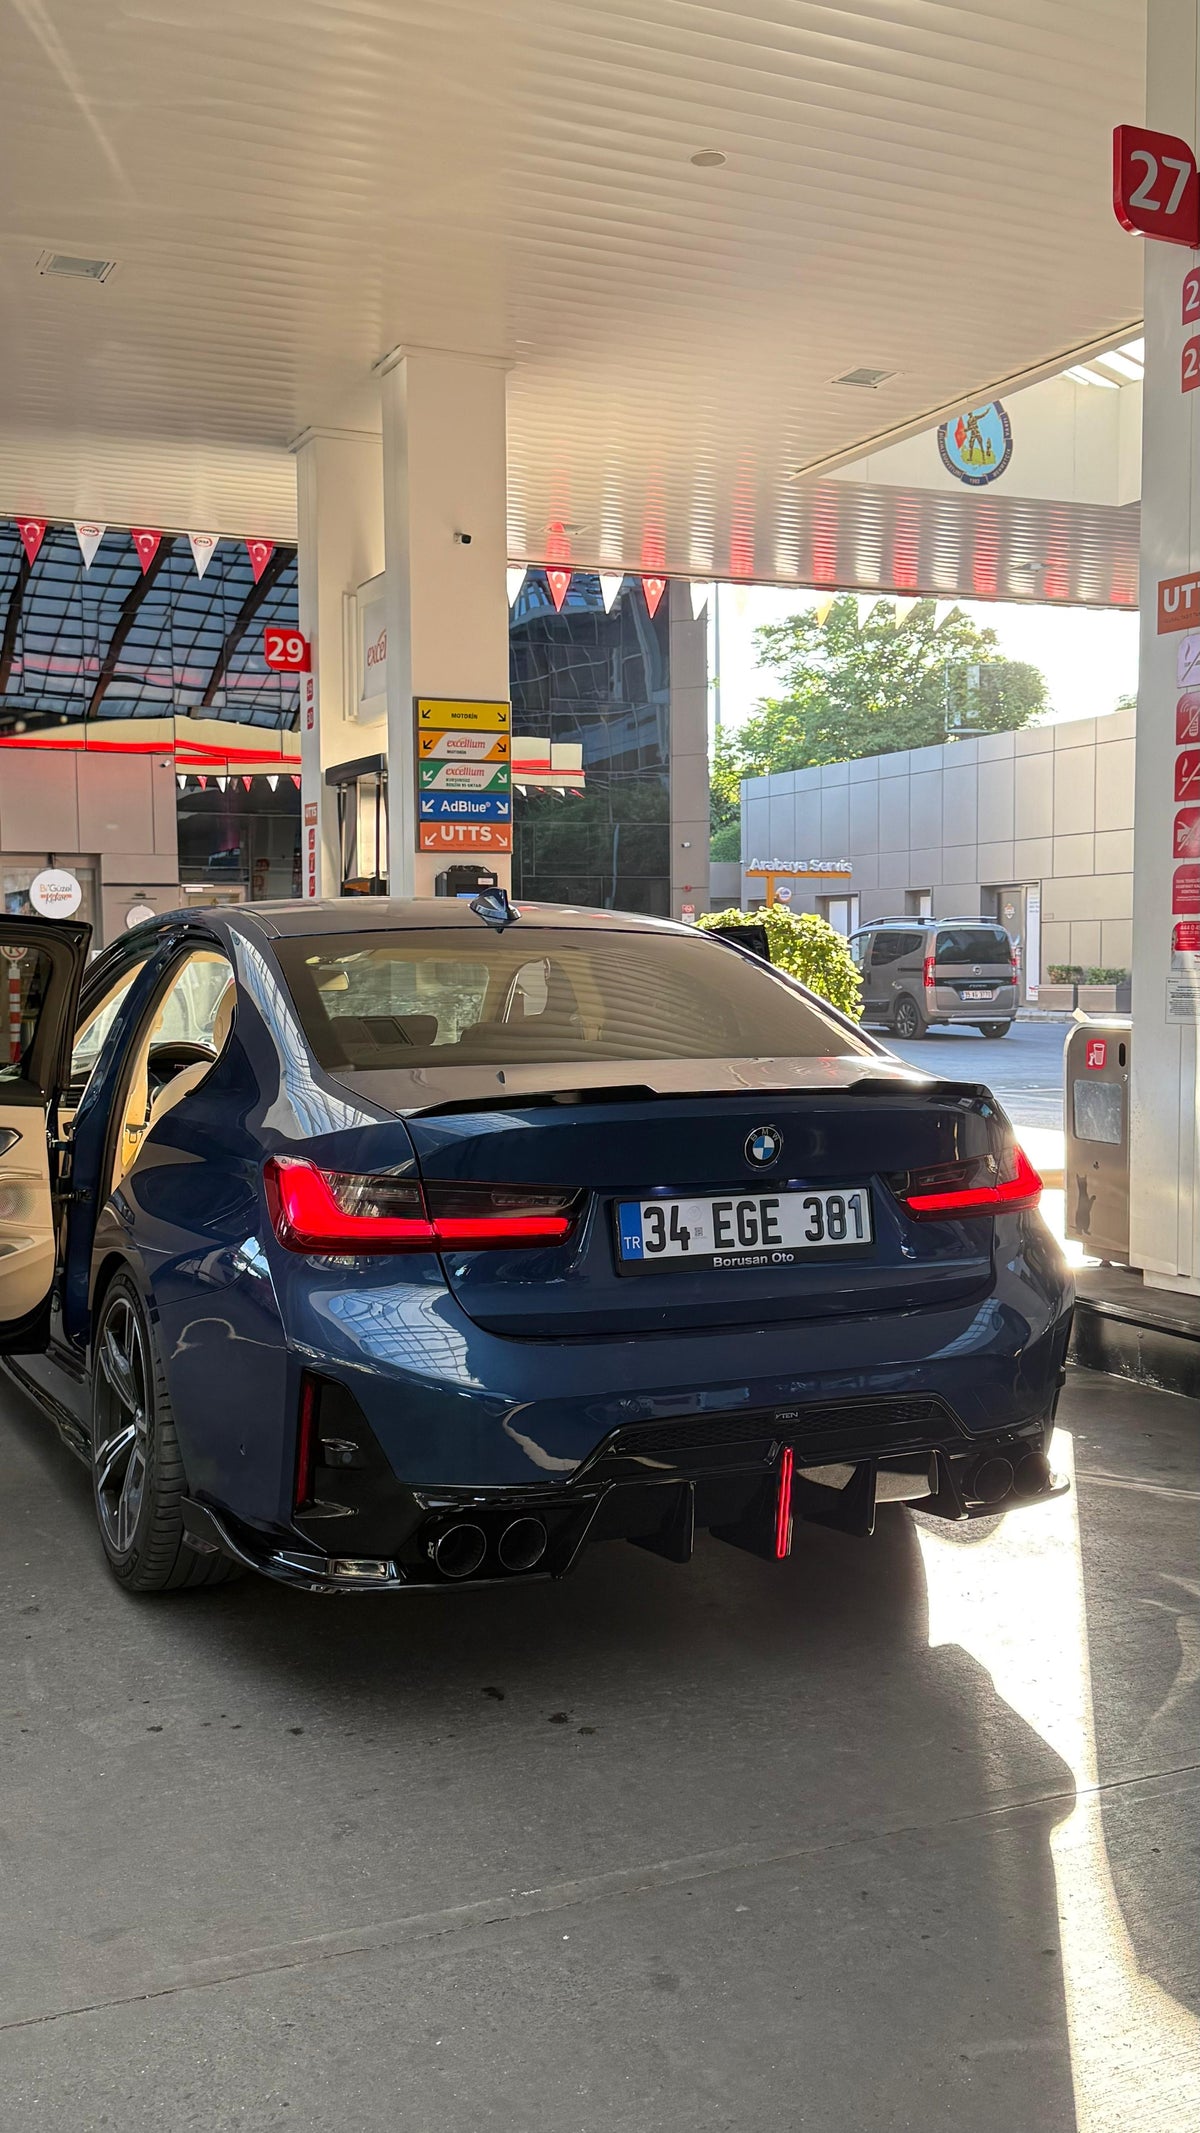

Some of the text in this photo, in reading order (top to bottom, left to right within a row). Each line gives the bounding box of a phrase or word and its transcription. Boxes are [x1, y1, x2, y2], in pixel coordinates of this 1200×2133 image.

[1129, 150, 1192, 215] 27
[1183, 347, 1200, 379] 2
[1163, 582, 1200, 613] UT
[268, 636, 304, 663] 29
[446, 739, 486, 749] excellium
[445, 765, 485, 777] excellium
[440, 825, 492, 842] UTTS
[749, 858, 808, 874] Arabaya
[750, 1127, 779, 1141] BMW
[623, 1194, 863, 1252] TR 34 EGE 381
[713, 1252, 795, 1268] Borusan Oto
